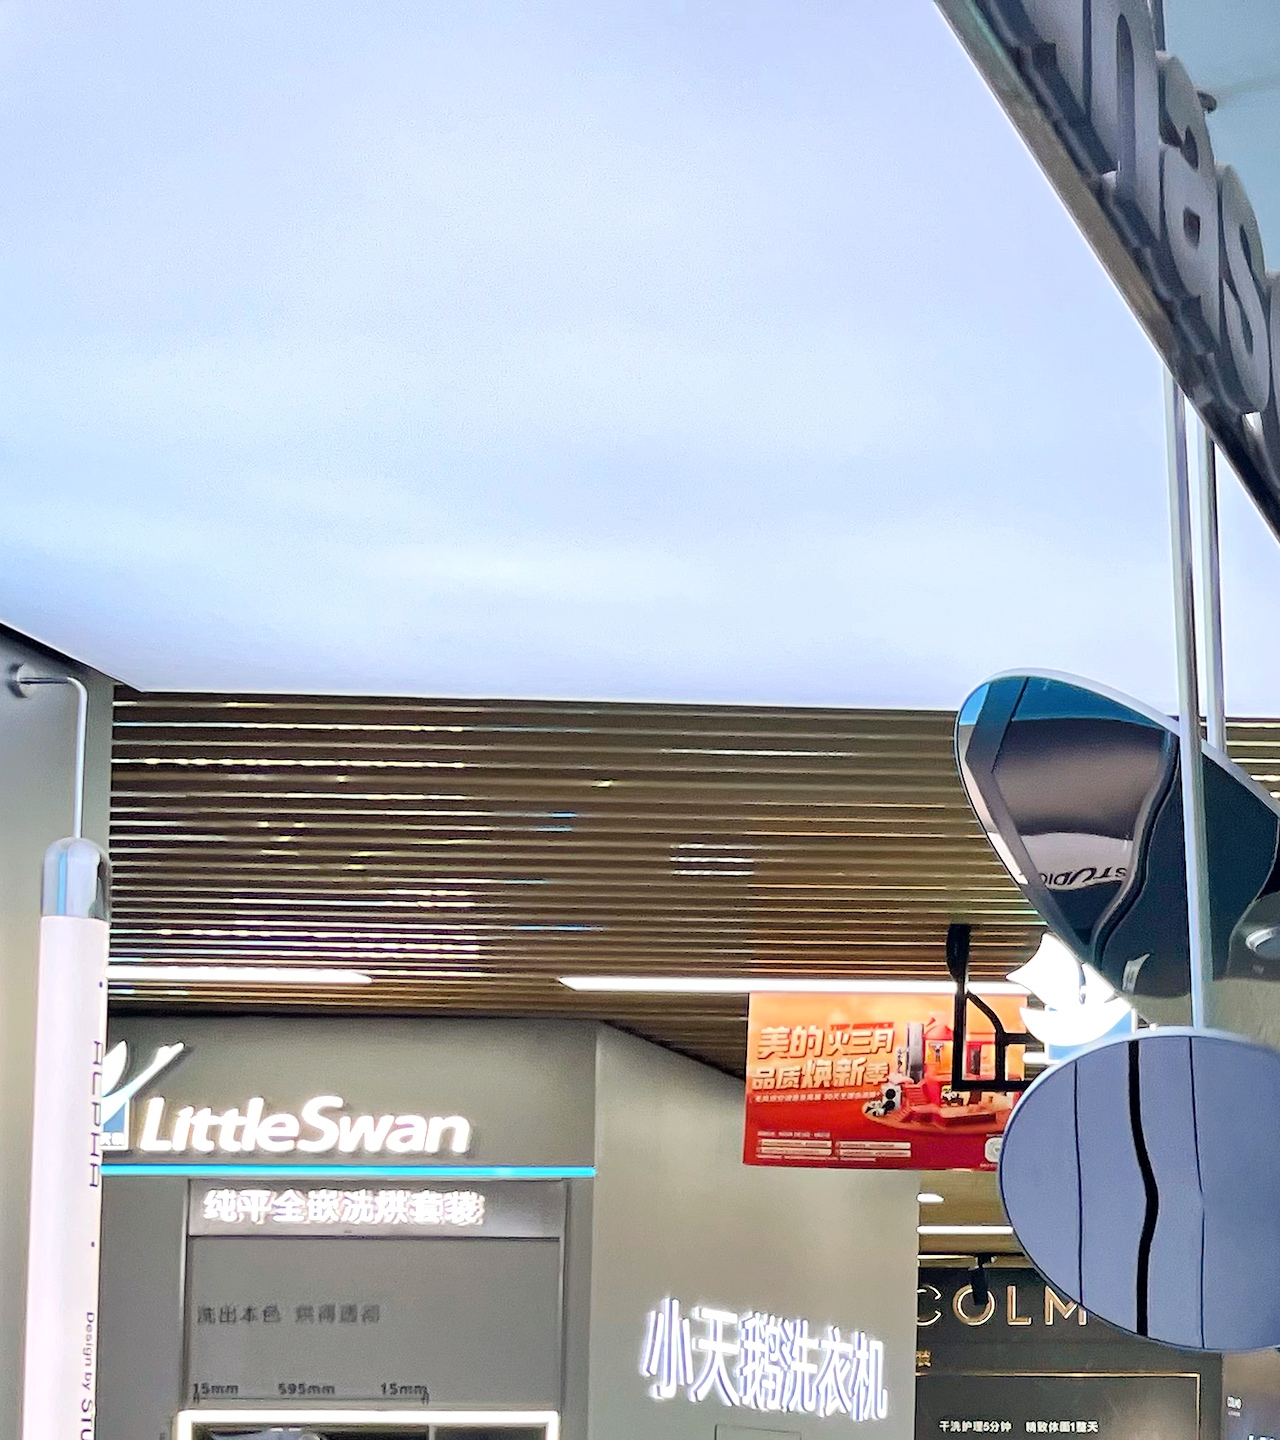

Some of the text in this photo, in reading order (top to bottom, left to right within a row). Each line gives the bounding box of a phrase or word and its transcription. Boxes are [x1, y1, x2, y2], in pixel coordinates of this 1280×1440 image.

[757, 1024, 896, 1060] 美的火三月
[751, 1057, 891, 1091] 品质焕新季
[139, 1096, 473, 1154] LittleSwan
[938, 1420, 1013, 1433] 干洗护理5分钟
